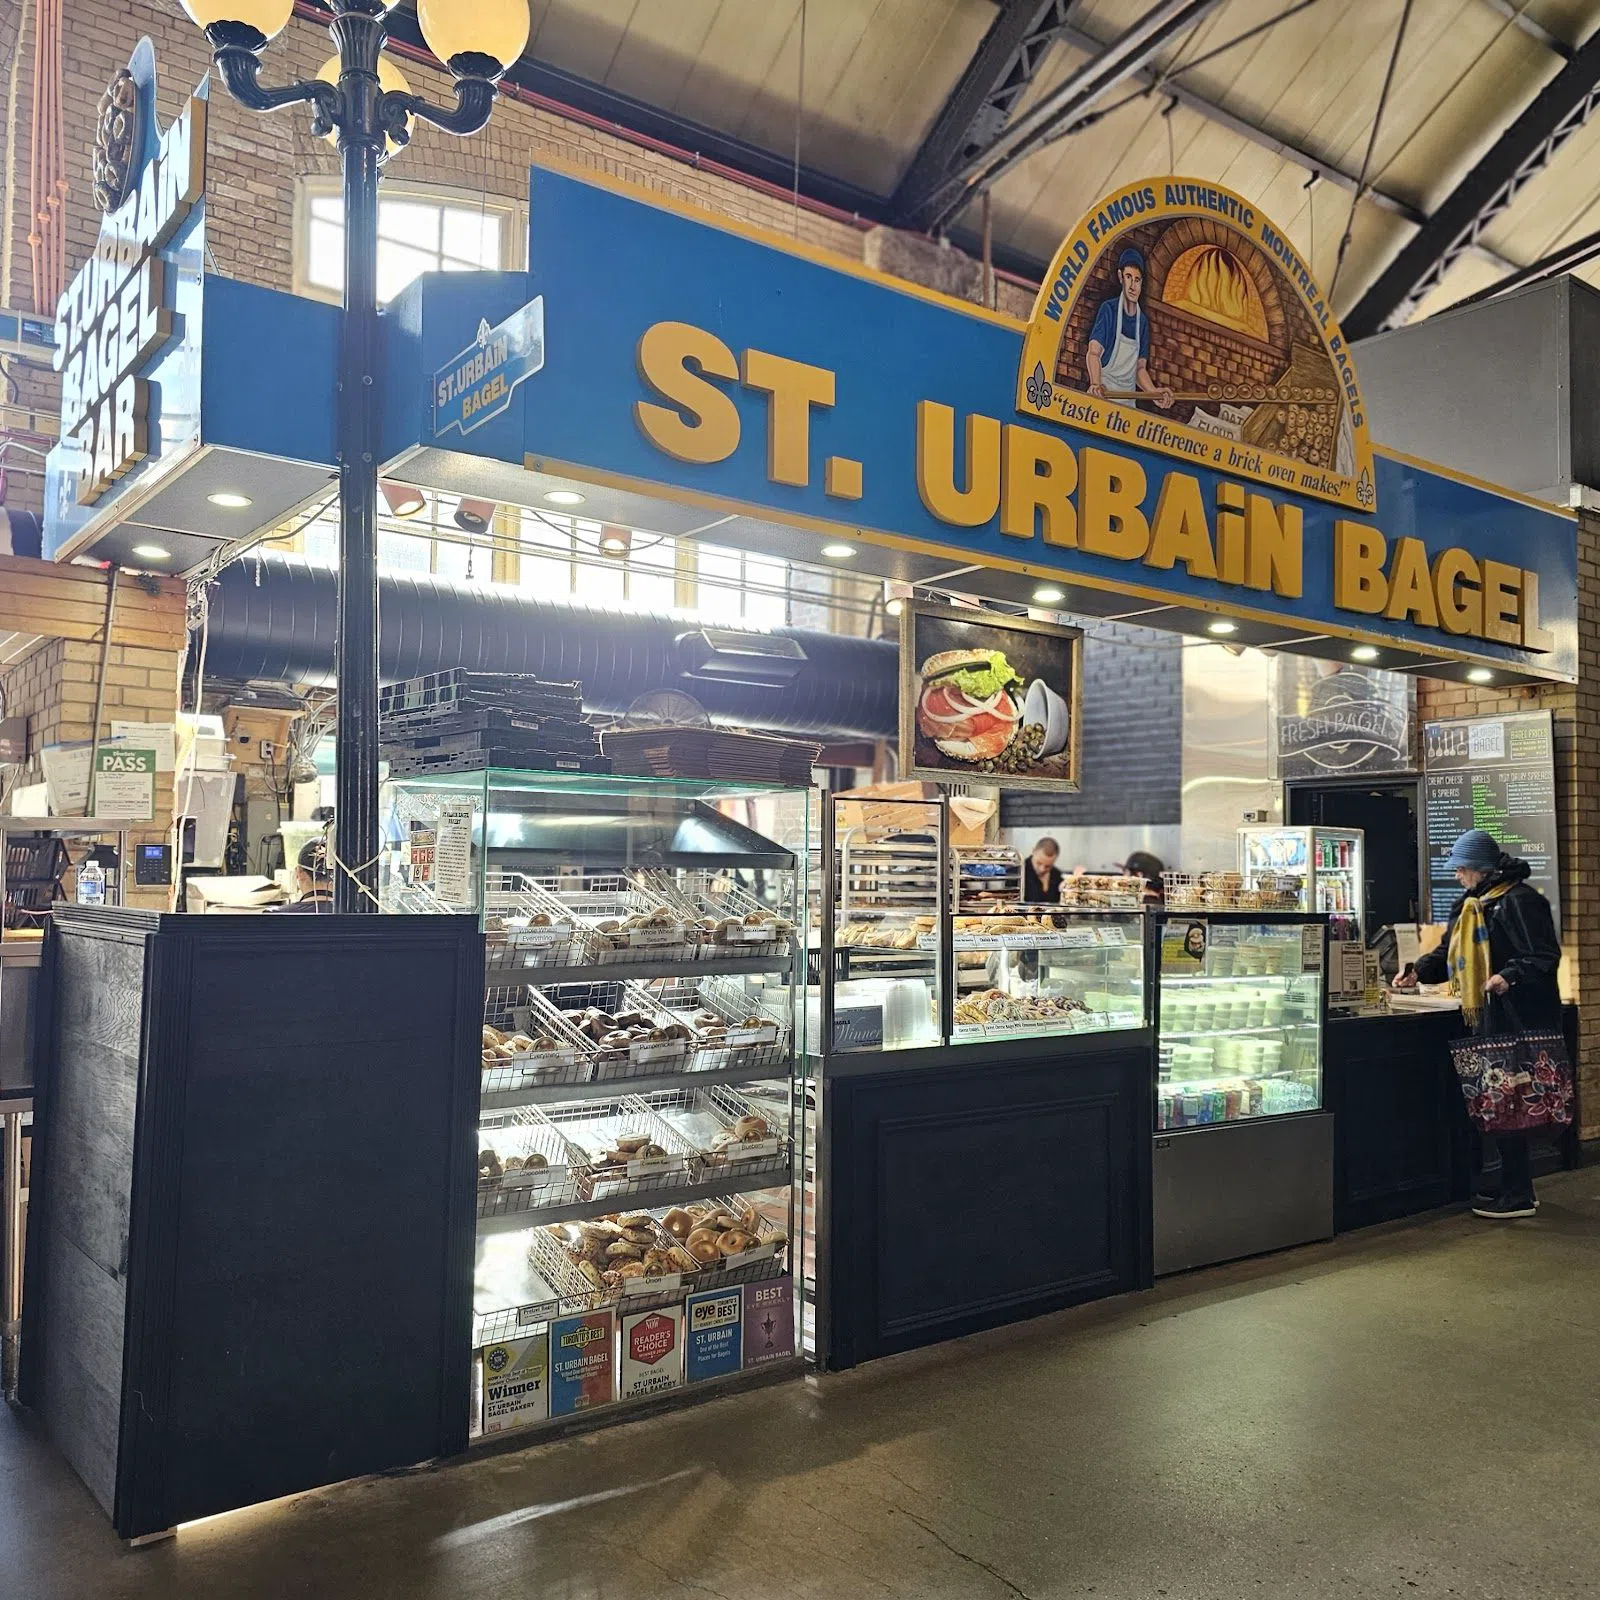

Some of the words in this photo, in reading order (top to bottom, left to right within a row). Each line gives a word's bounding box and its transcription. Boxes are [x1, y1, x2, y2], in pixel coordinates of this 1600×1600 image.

[1044, 240, 1090, 322] WORLD
[1087, 187, 1156, 243] FAMOUS
[1165, 184, 1254, 229] AUTHENTIC
[1261, 223, 1331, 330] MONTREAL
[1329, 335, 1363, 428] BAGELS
[60, 256, 157, 442] BAGEL
[462, 372, 509, 420] BAGEL
[77, 374, 137, 505] BAR
[1106, 411, 1131, 434] the
[1136, 420, 1209, 456] difference
[1213, 450, 1222, 462] a
[1228, 447, 1263, 474] brick
[1268, 463, 1296, 483] oven
[634, 321, 863, 500] ST.
[1334, 519, 1554, 653] BAGEL
[1281, 715, 1328, 746] FRESH
[1332, 711, 1400, 741] BAGELS
[102, 756, 147, 772] PASS
[755, 1287, 783, 1302] BEST
[695, 1305, 715, 1320] eye
[717, 1304, 737, 1318] BEST
[634, 1330, 671, 1346] READER'S
[696, 1334, 706, 1345] ST.
[707, 1328, 733, 1342] URBAIN
[637, 1339, 668, 1353] CHOICE
[565, 1357, 589, 1371] URBAIN
[589, 1352, 608, 1365] BAGEL
[634, 1381, 641, 1389] ST
[643, 1374, 670, 1387] URBAIN
[488, 1380, 541, 1401] Winner
[488, 1408, 509, 1418] BAGEL
[510, 1402, 535, 1412] BAKERY
[497, 1400, 521, 1410] URBAIN
